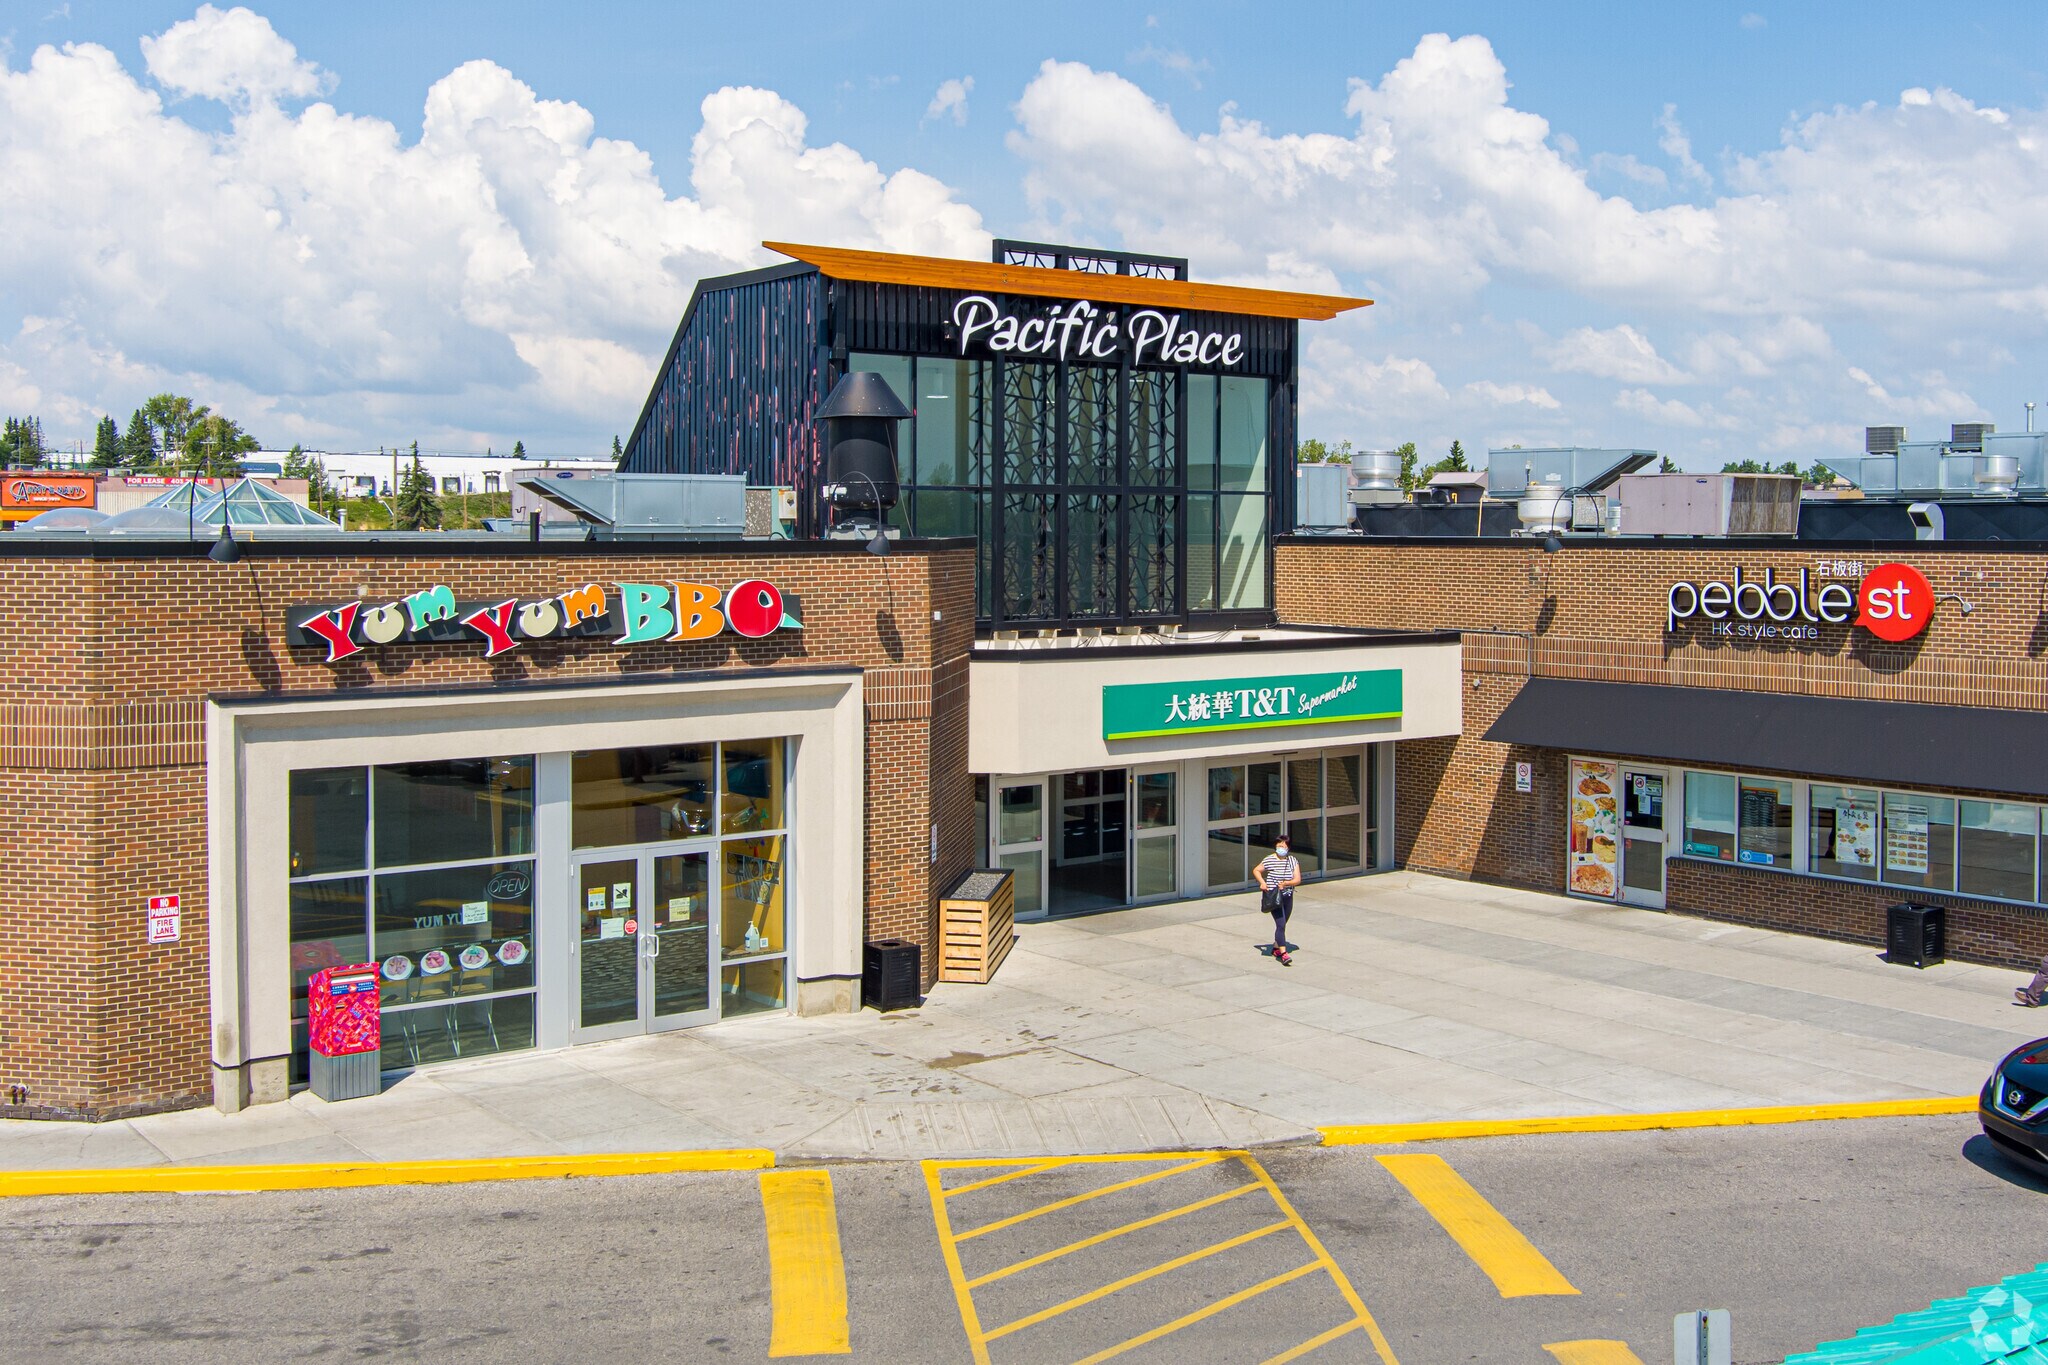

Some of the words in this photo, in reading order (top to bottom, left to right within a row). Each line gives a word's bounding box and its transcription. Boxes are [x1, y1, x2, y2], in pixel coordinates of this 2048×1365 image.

[953, 295, 1118, 361] Pacific
[1128, 310, 1244, 366] Place
[1816, 560, 1864, 577] 石板街
[1668, 566, 1853, 632] pebble
[1867, 580, 1912, 620] st
[611, 579, 804, 645] BBQ
[1712, 622, 1732, 636] HK
[1737, 623, 1777, 640] style
[1782, 624, 1818, 640] cafe
[1298, 675, 1358, 716] Supermarket
[489, 878, 526, 894] OPEN
[160, 898, 169, 907] NO
[151, 906, 178, 918] PARKING
[413, 914, 443, 929] YUM
[447, 912, 463, 926] YU
[156, 919, 173, 927] FIRE
[156, 926, 174, 935] LANE
